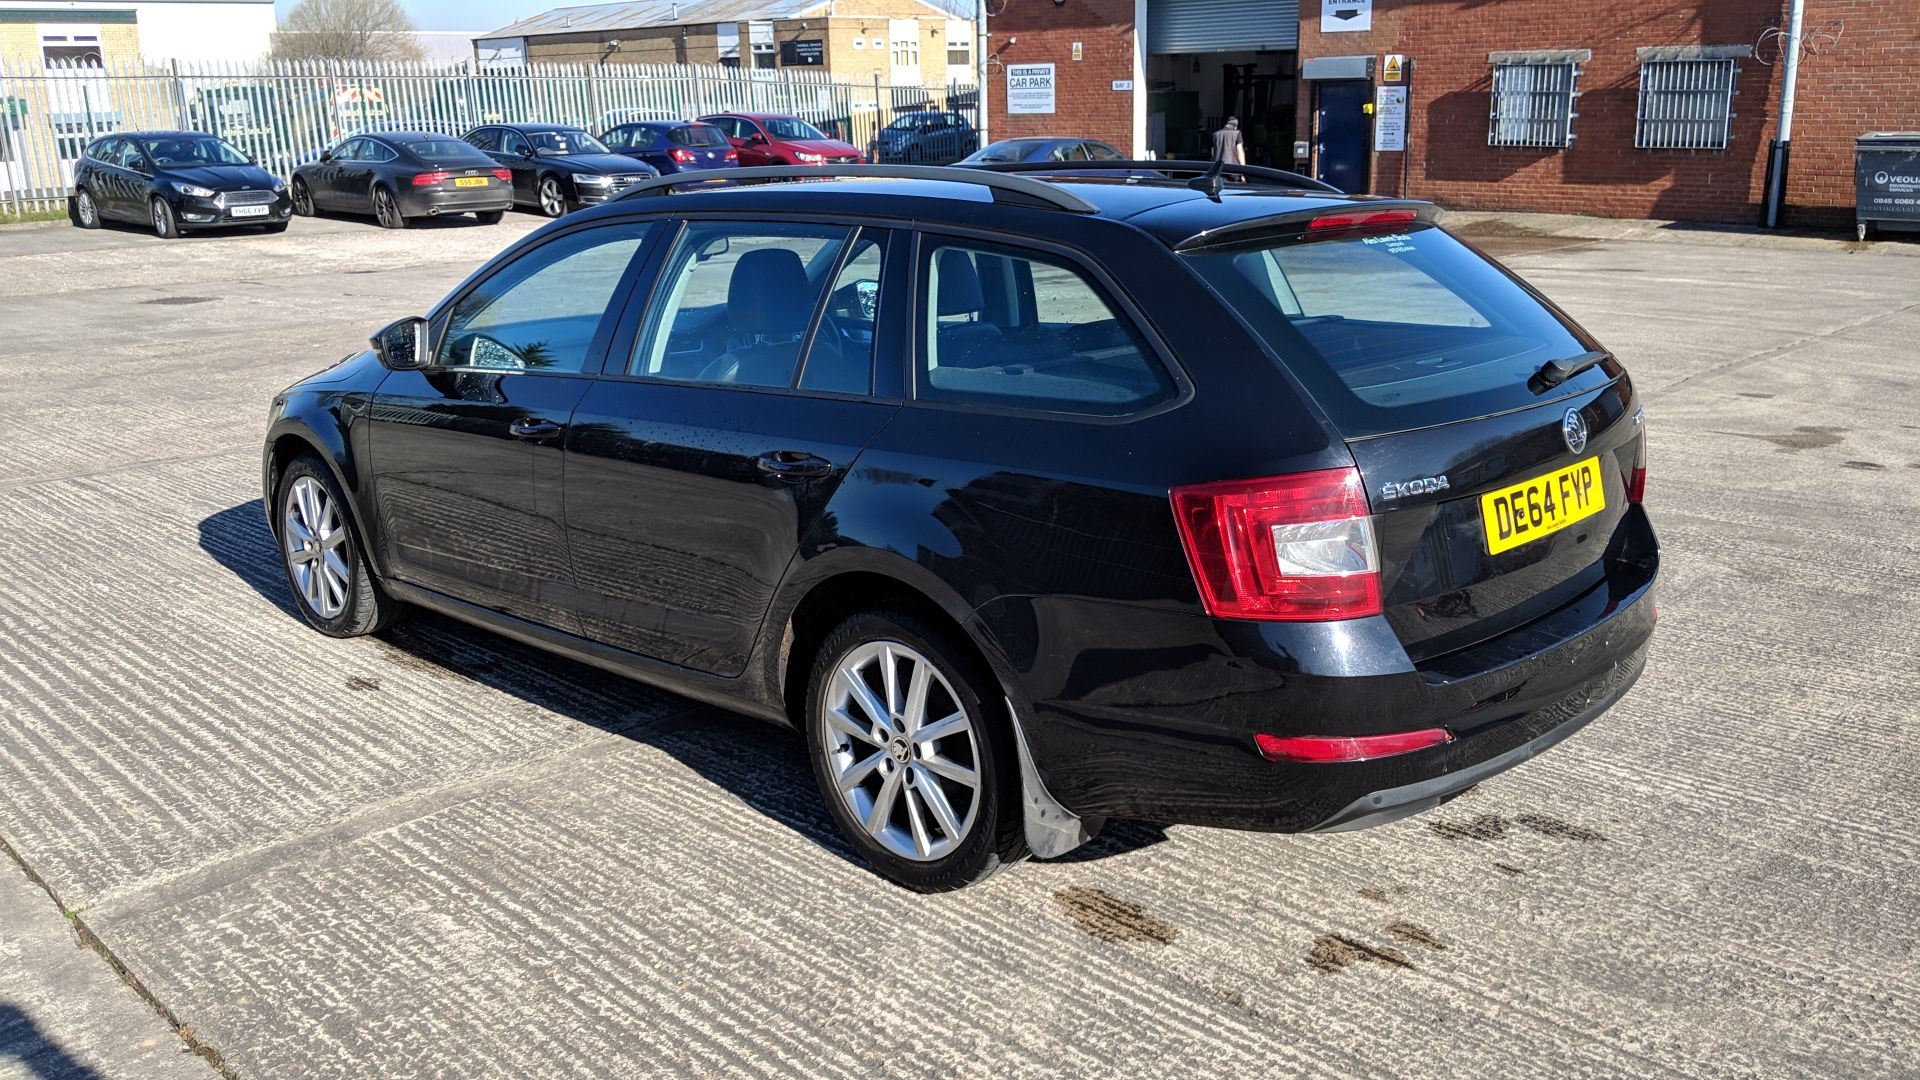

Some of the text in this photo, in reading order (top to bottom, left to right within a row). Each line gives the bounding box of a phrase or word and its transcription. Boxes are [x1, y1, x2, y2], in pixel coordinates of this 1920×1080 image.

[1010, 77, 1052, 88] CAR PARK
[1493, 465, 1592, 541] DE64 FYP
